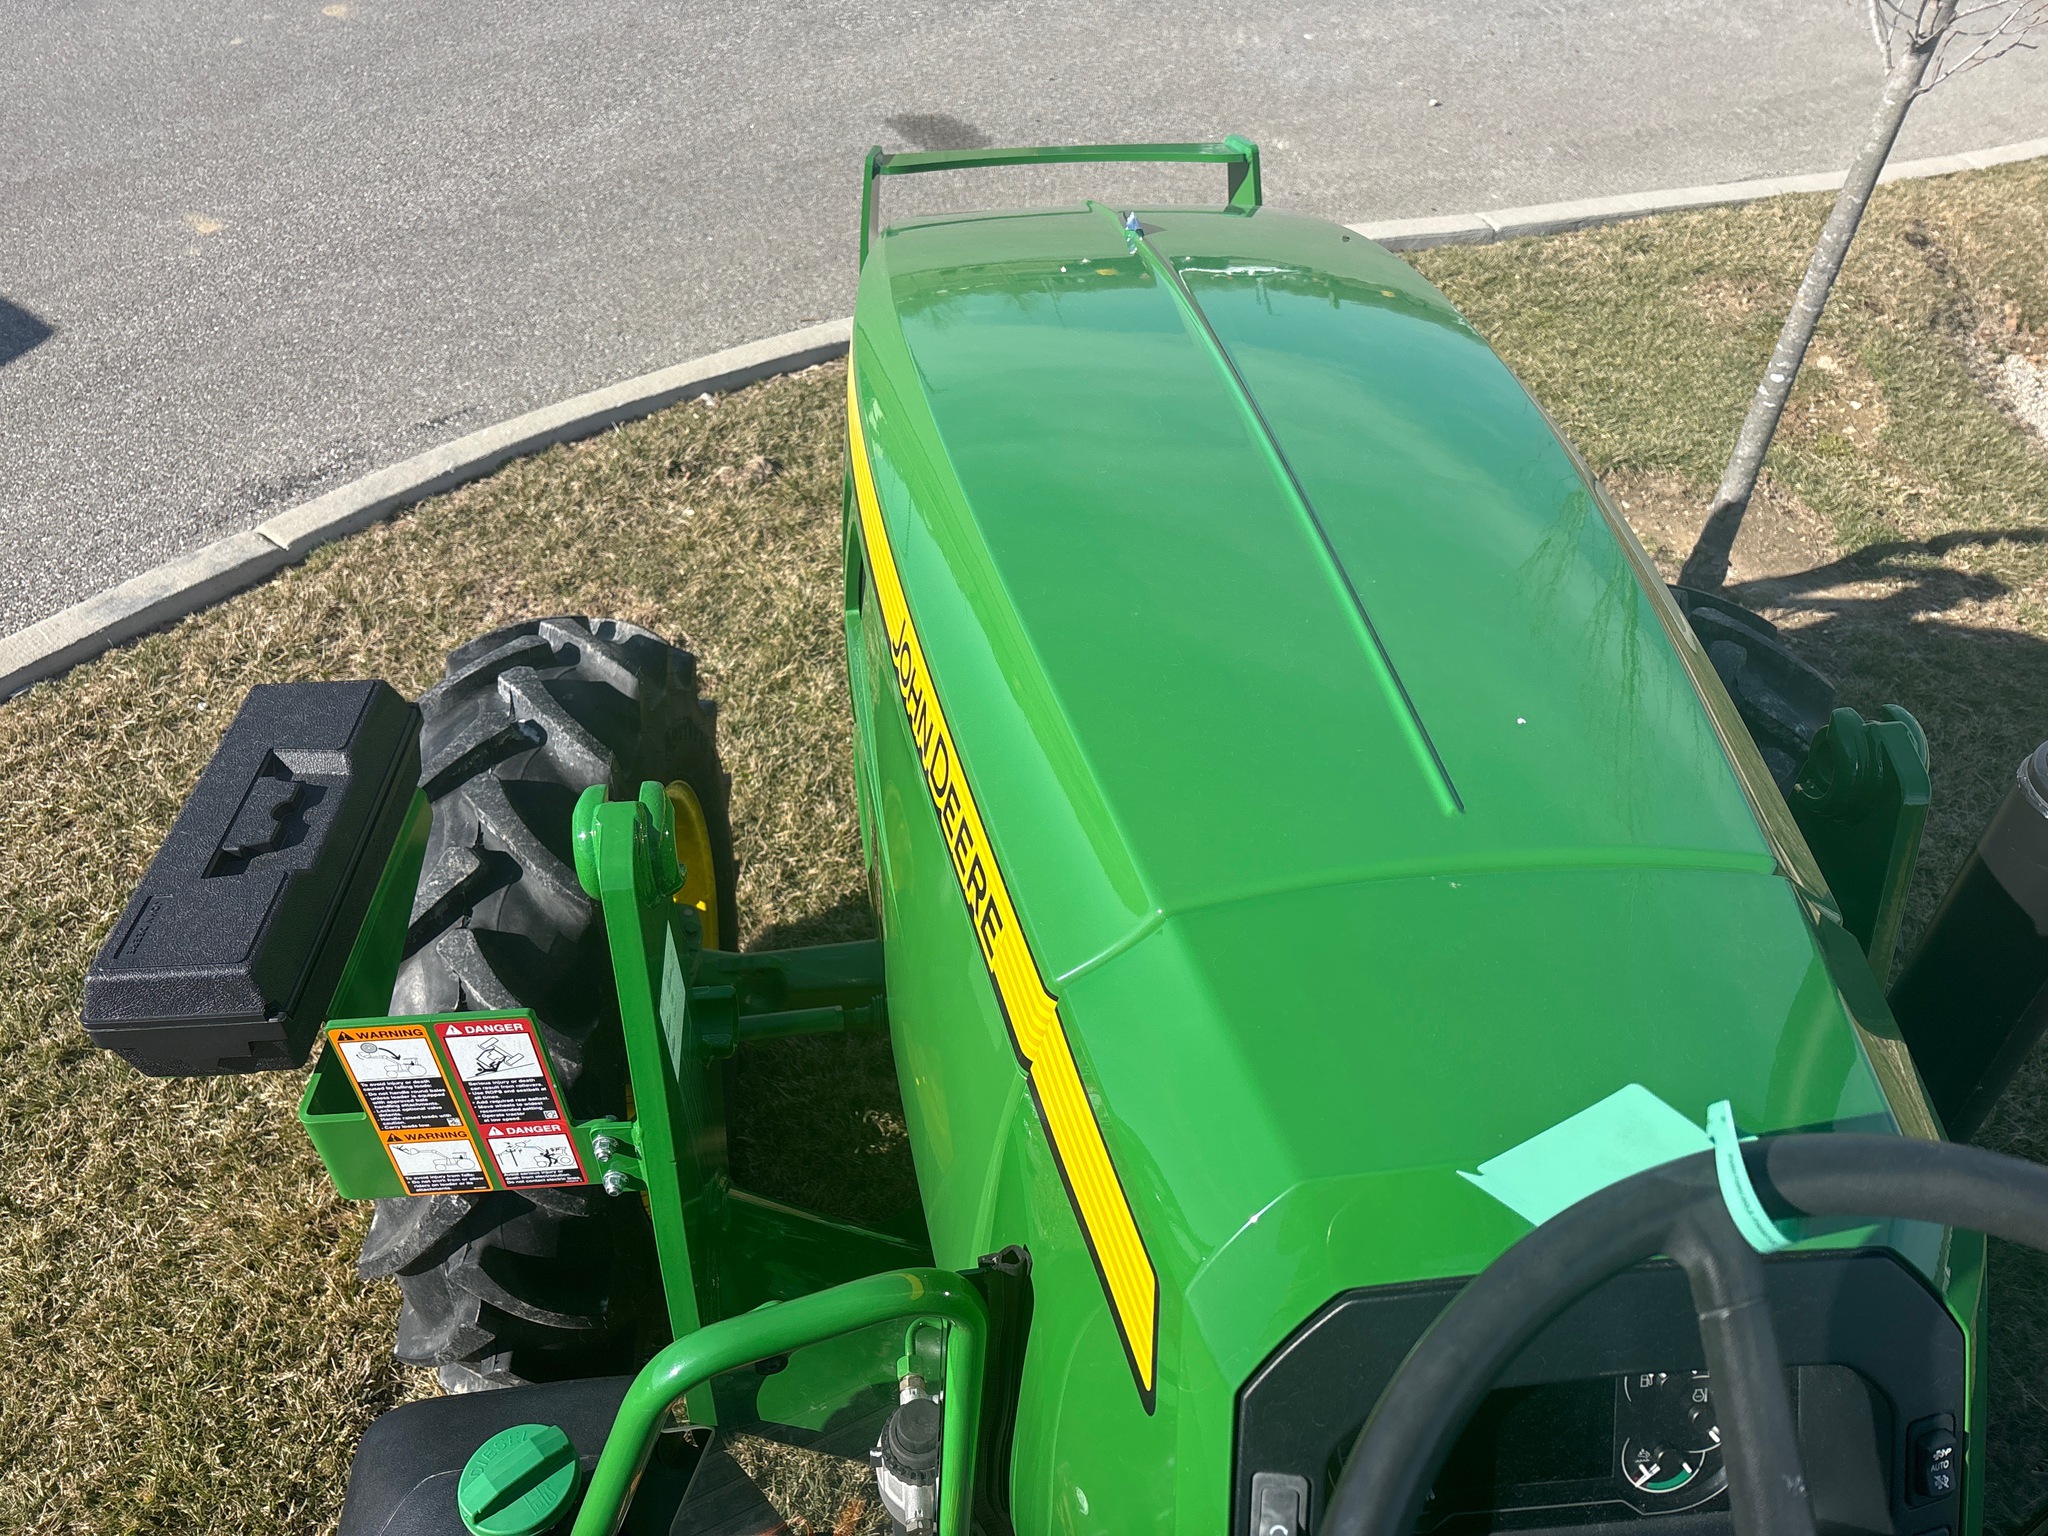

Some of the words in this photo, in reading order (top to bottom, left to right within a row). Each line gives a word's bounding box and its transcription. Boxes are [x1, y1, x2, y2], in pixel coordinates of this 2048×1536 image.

[892, 619, 934, 760] JOHN
[930, 732, 1003, 959] DEERE
[355, 1028, 423, 1039] WARNING
[465, 1023, 524, 1034] DANGER
[506, 1124, 561, 1134] DANGER
[404, 1131, 467, 1141] WARNING
[1931, 1460, 1949, 1472] AUTO
